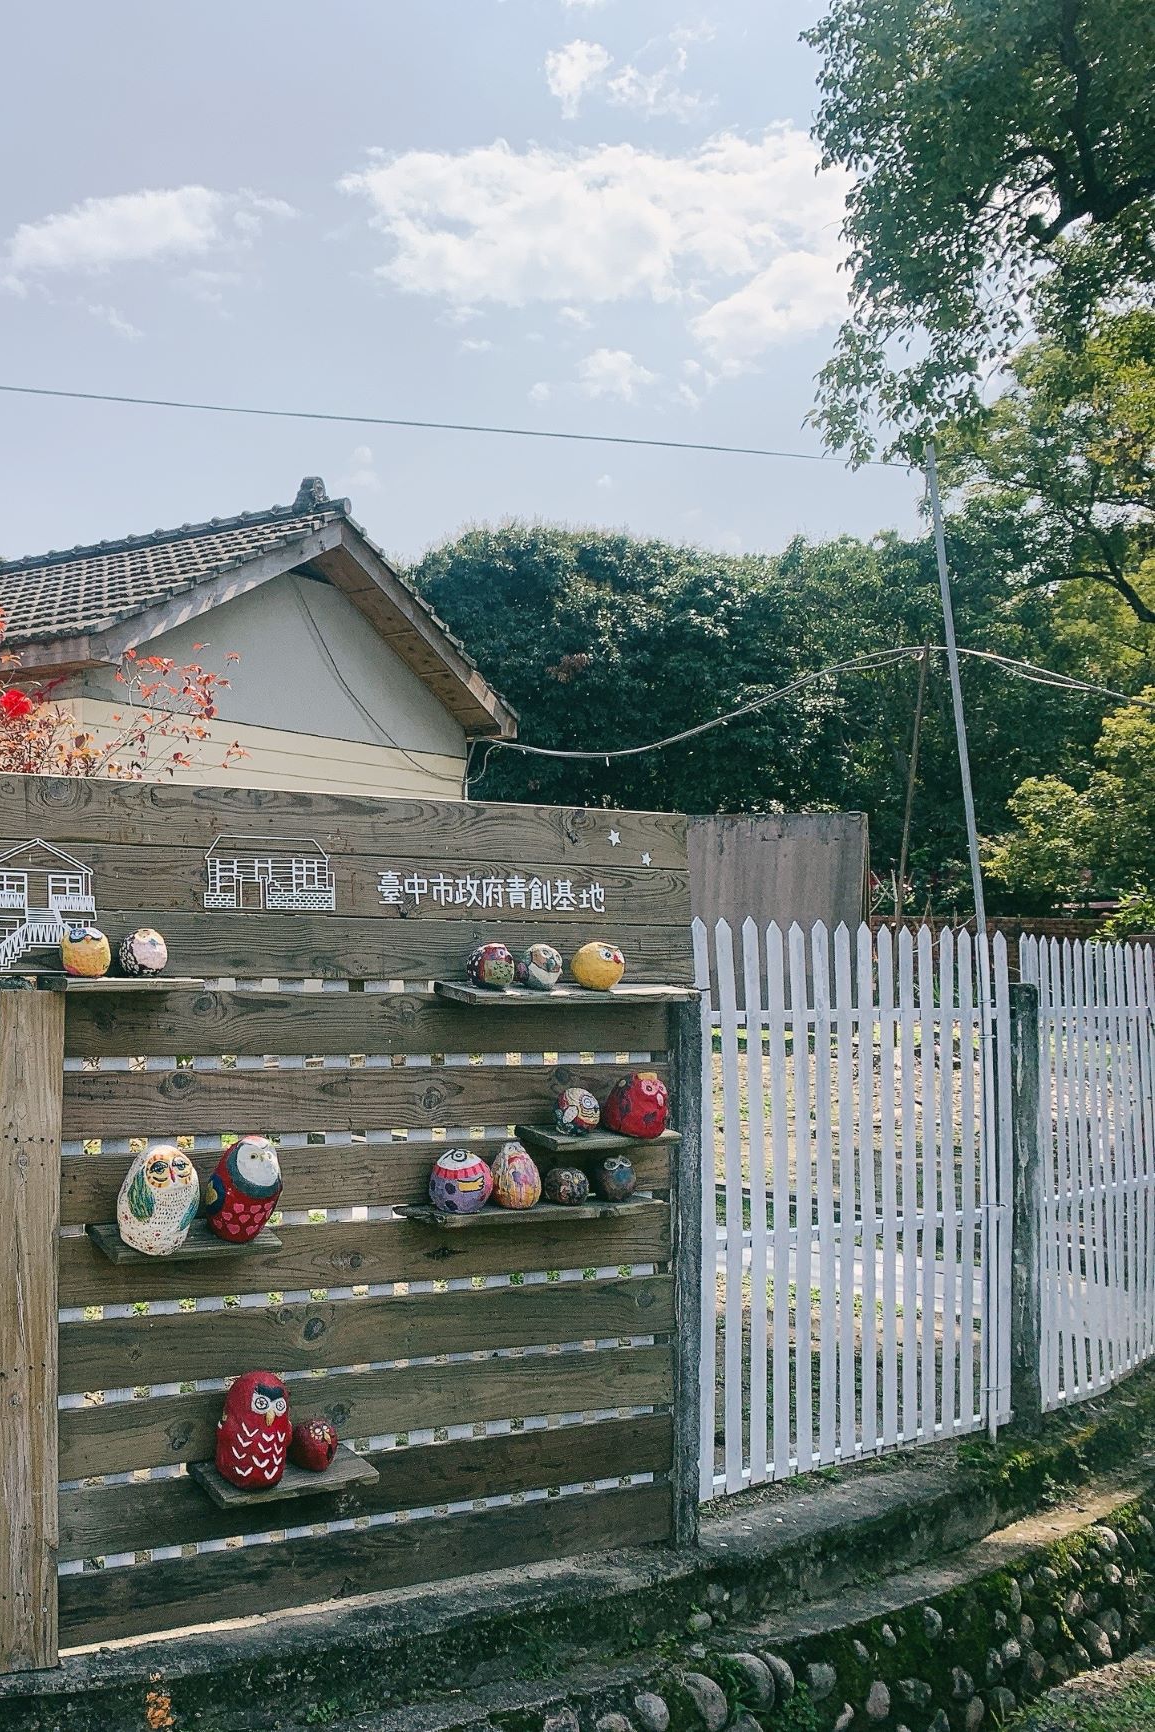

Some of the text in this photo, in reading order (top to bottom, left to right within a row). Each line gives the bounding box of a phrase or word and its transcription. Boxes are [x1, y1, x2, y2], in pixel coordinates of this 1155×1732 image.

[377, 870, 606, 913] 臺中市政府青創基地
